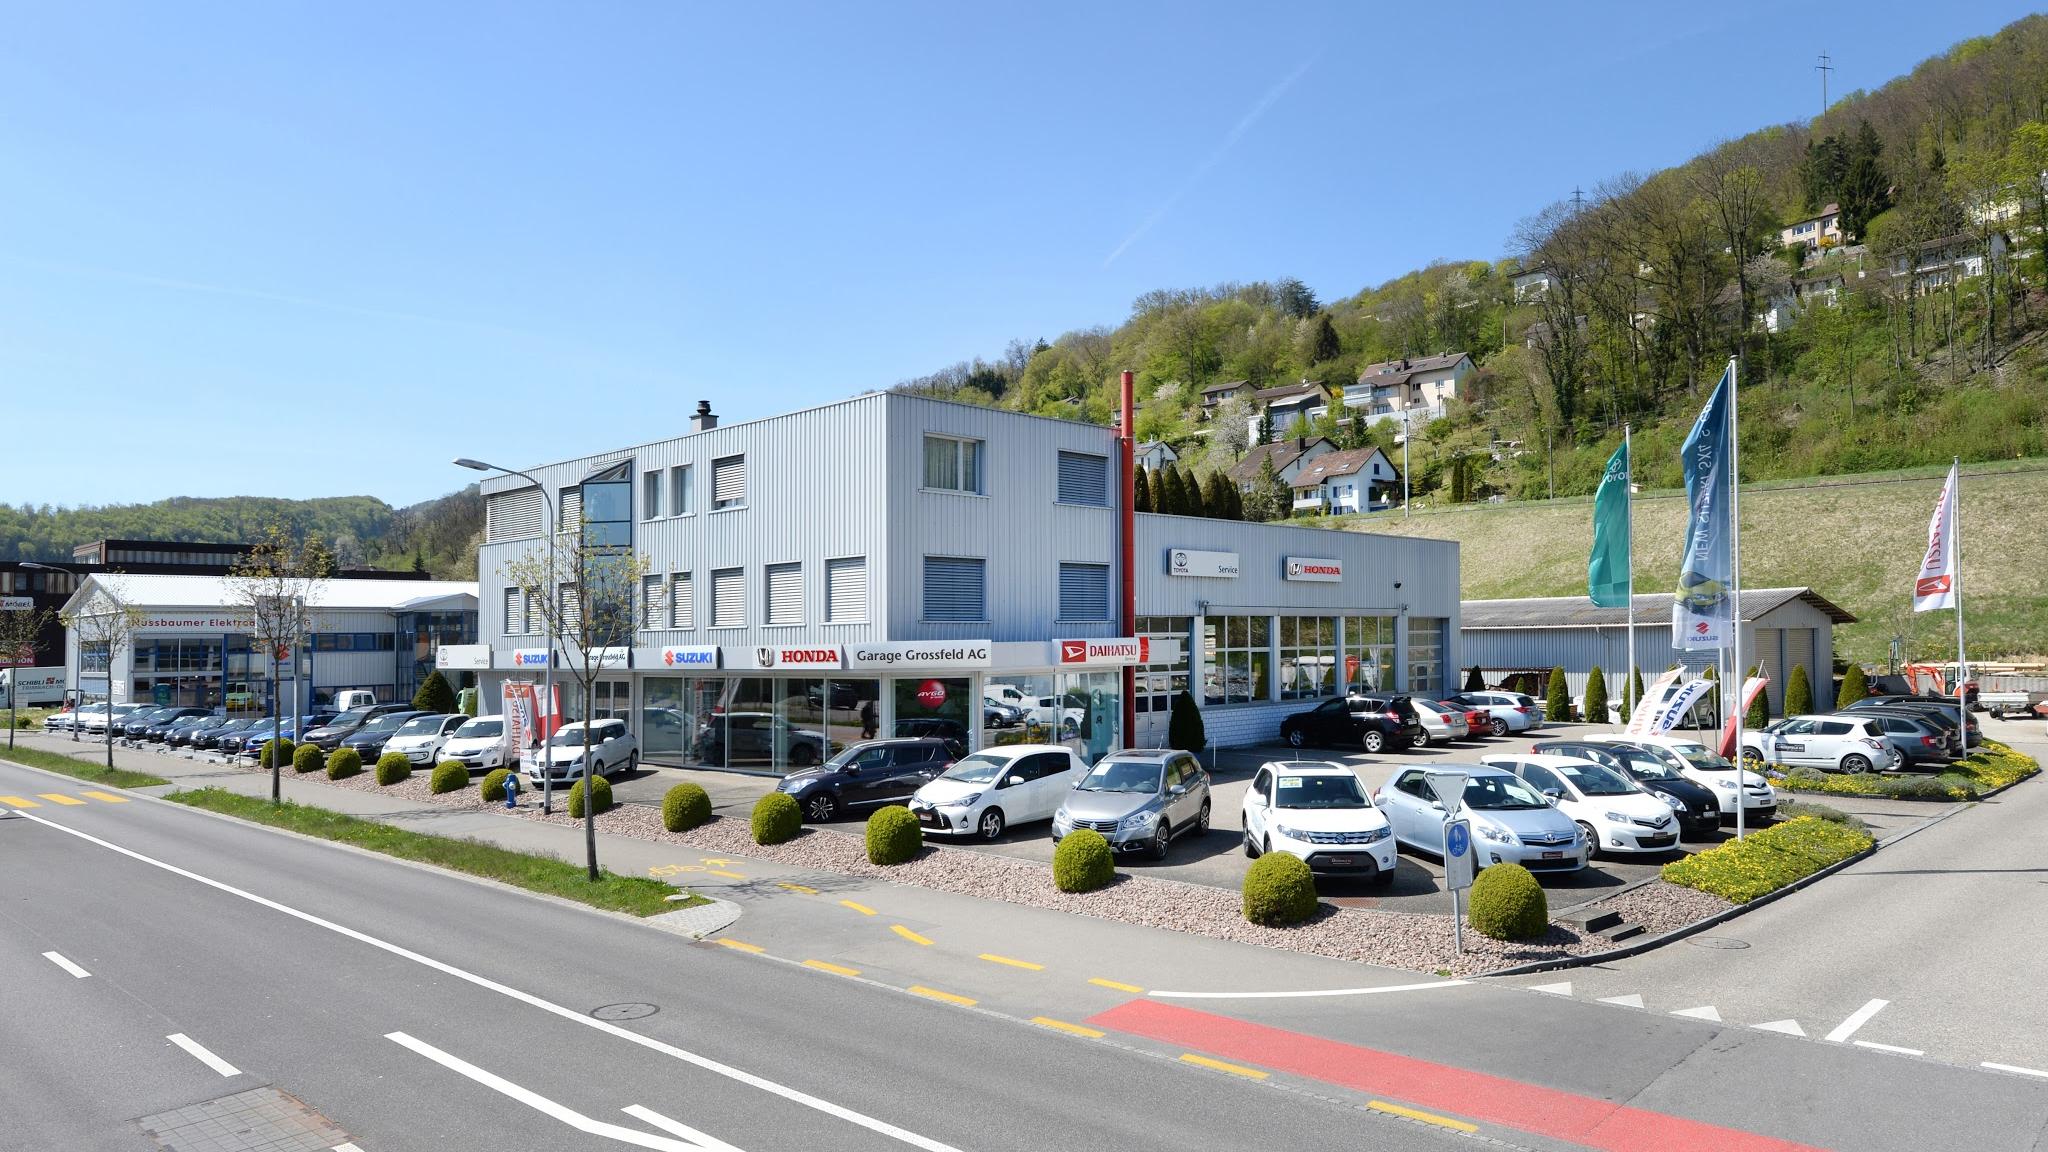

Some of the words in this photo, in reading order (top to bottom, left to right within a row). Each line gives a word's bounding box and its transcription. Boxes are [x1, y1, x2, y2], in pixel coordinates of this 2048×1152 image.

[1218, 565, 1238, 574] Service
[1304, 565, 1341, 575] HONDA
[132, 618, 205, 627] Nussbaumer
[1090, 645, 1137, 656] DAIHATSU
[474, 656, 488, 665] Service
[523, 654, 548, 663] SUZUK
[676, 652, 713, 663] SUZUKI
[781, 649, 839, 663] HONDA
[857, 650, 901, 664] Garage
[906, 648, 964, 661] Grossfeld
[968, 648, 987, 660] AG
